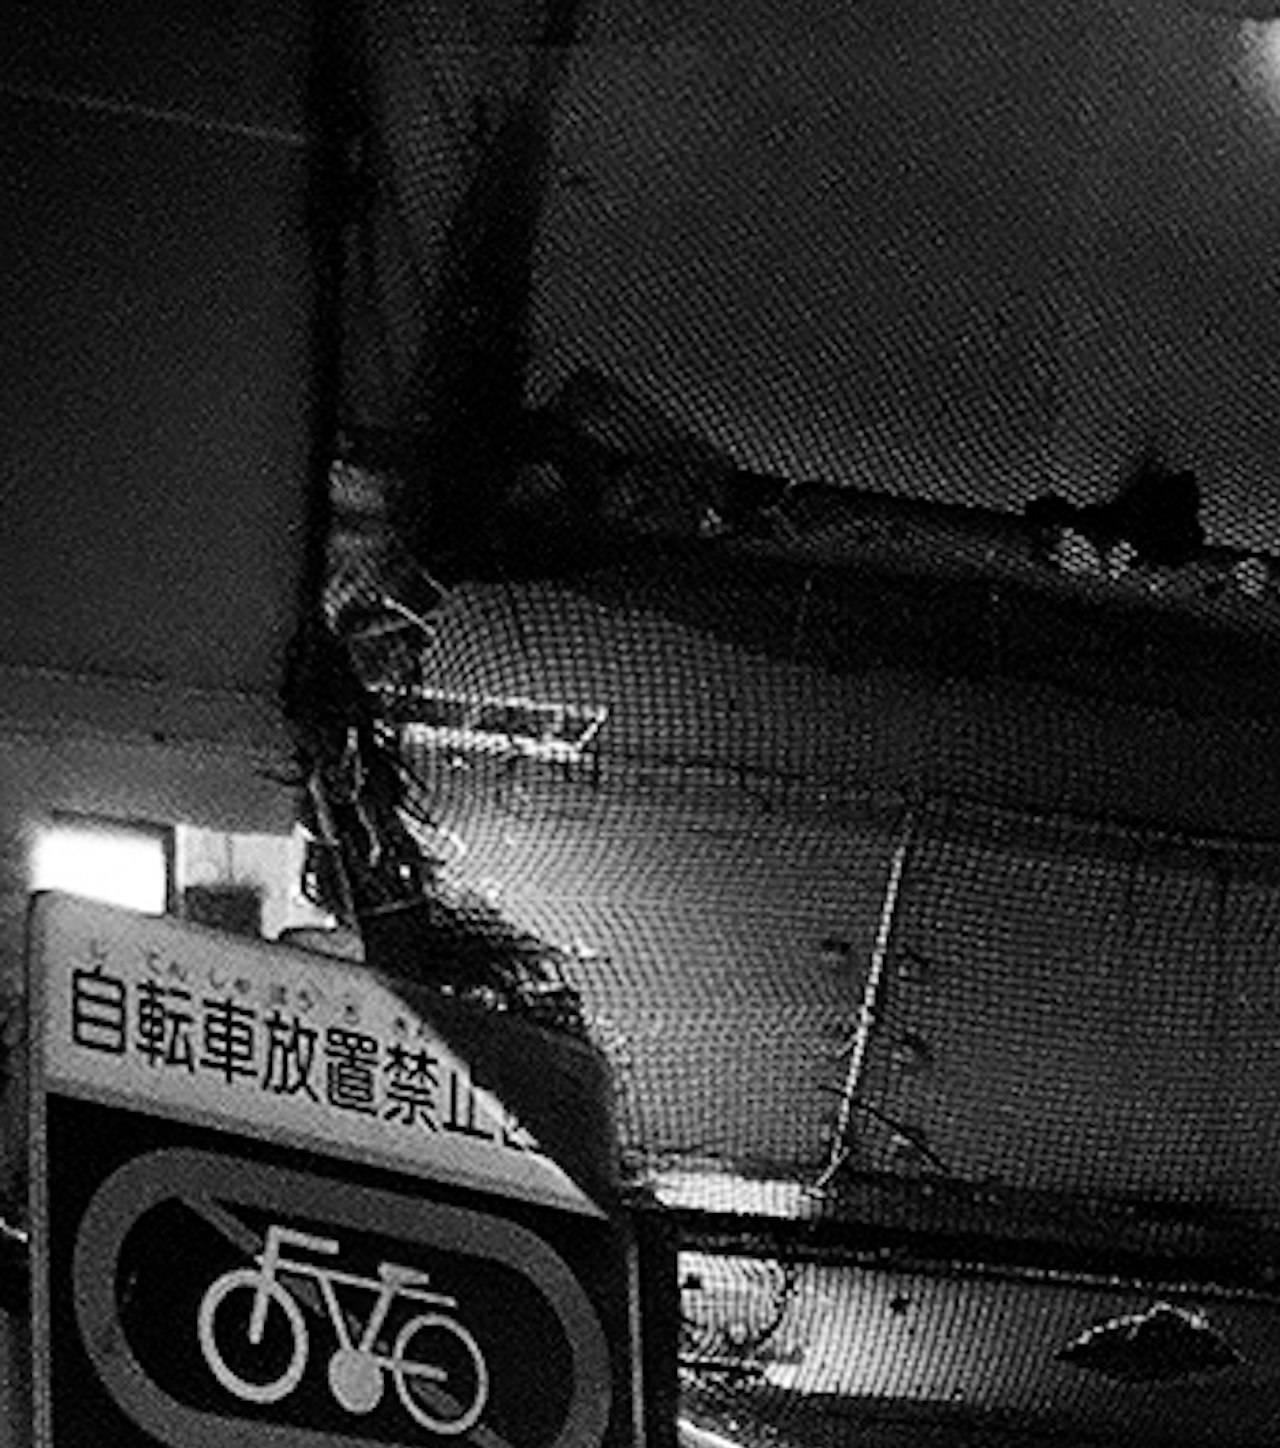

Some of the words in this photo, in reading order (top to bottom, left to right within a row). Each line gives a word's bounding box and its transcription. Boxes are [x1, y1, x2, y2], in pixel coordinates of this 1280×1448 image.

[72, 965, 536, 1152] 自転車放置禁止
